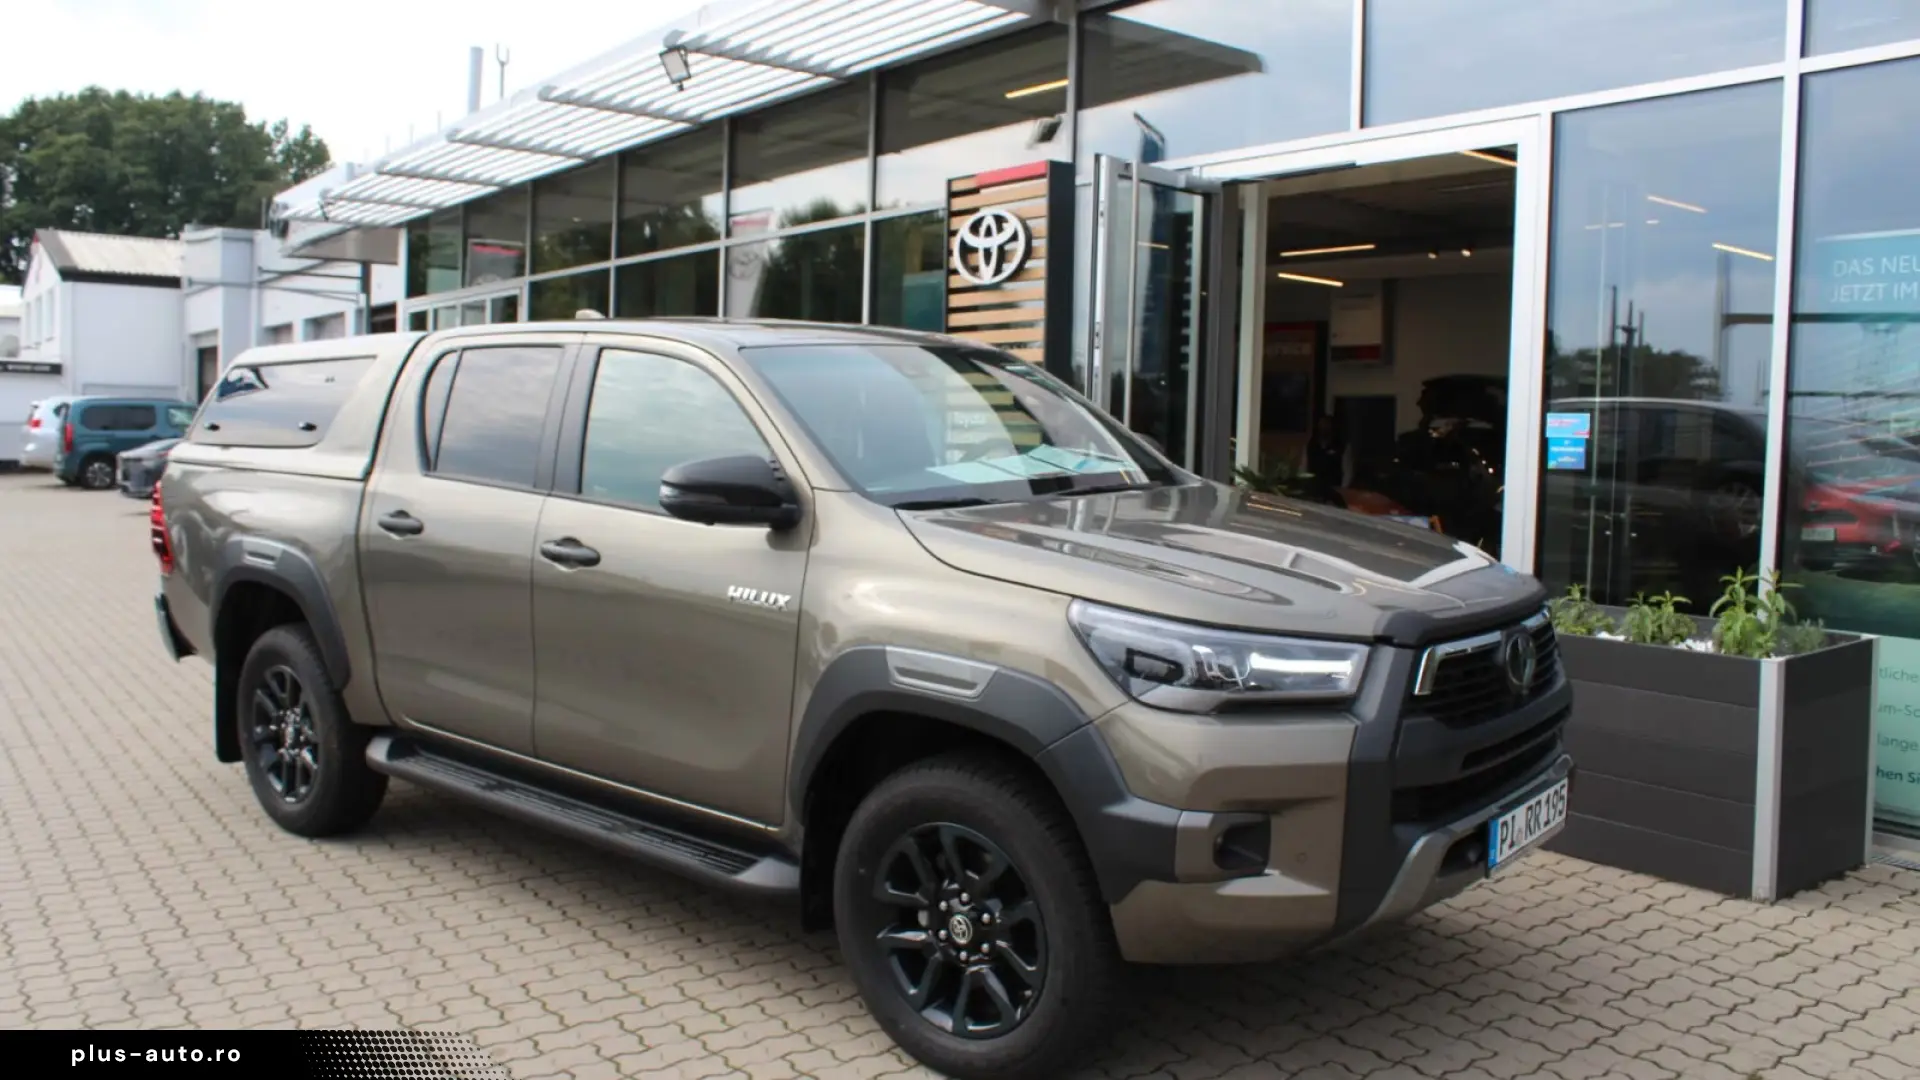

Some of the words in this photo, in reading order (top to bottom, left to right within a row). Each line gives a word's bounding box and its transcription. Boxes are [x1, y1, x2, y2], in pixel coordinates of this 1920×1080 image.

[1833, 257, 1874, 277] DAS
[1830, 283, 1887, 303] JETZT
[1893, 281, 1918, 301] IM
[727, 585, 792, 610] HILUX
[1500, 814, 1516, 856] PI
[1525, 798, 1542, 840] RR
[1544, 783, 1566, 828] 195
